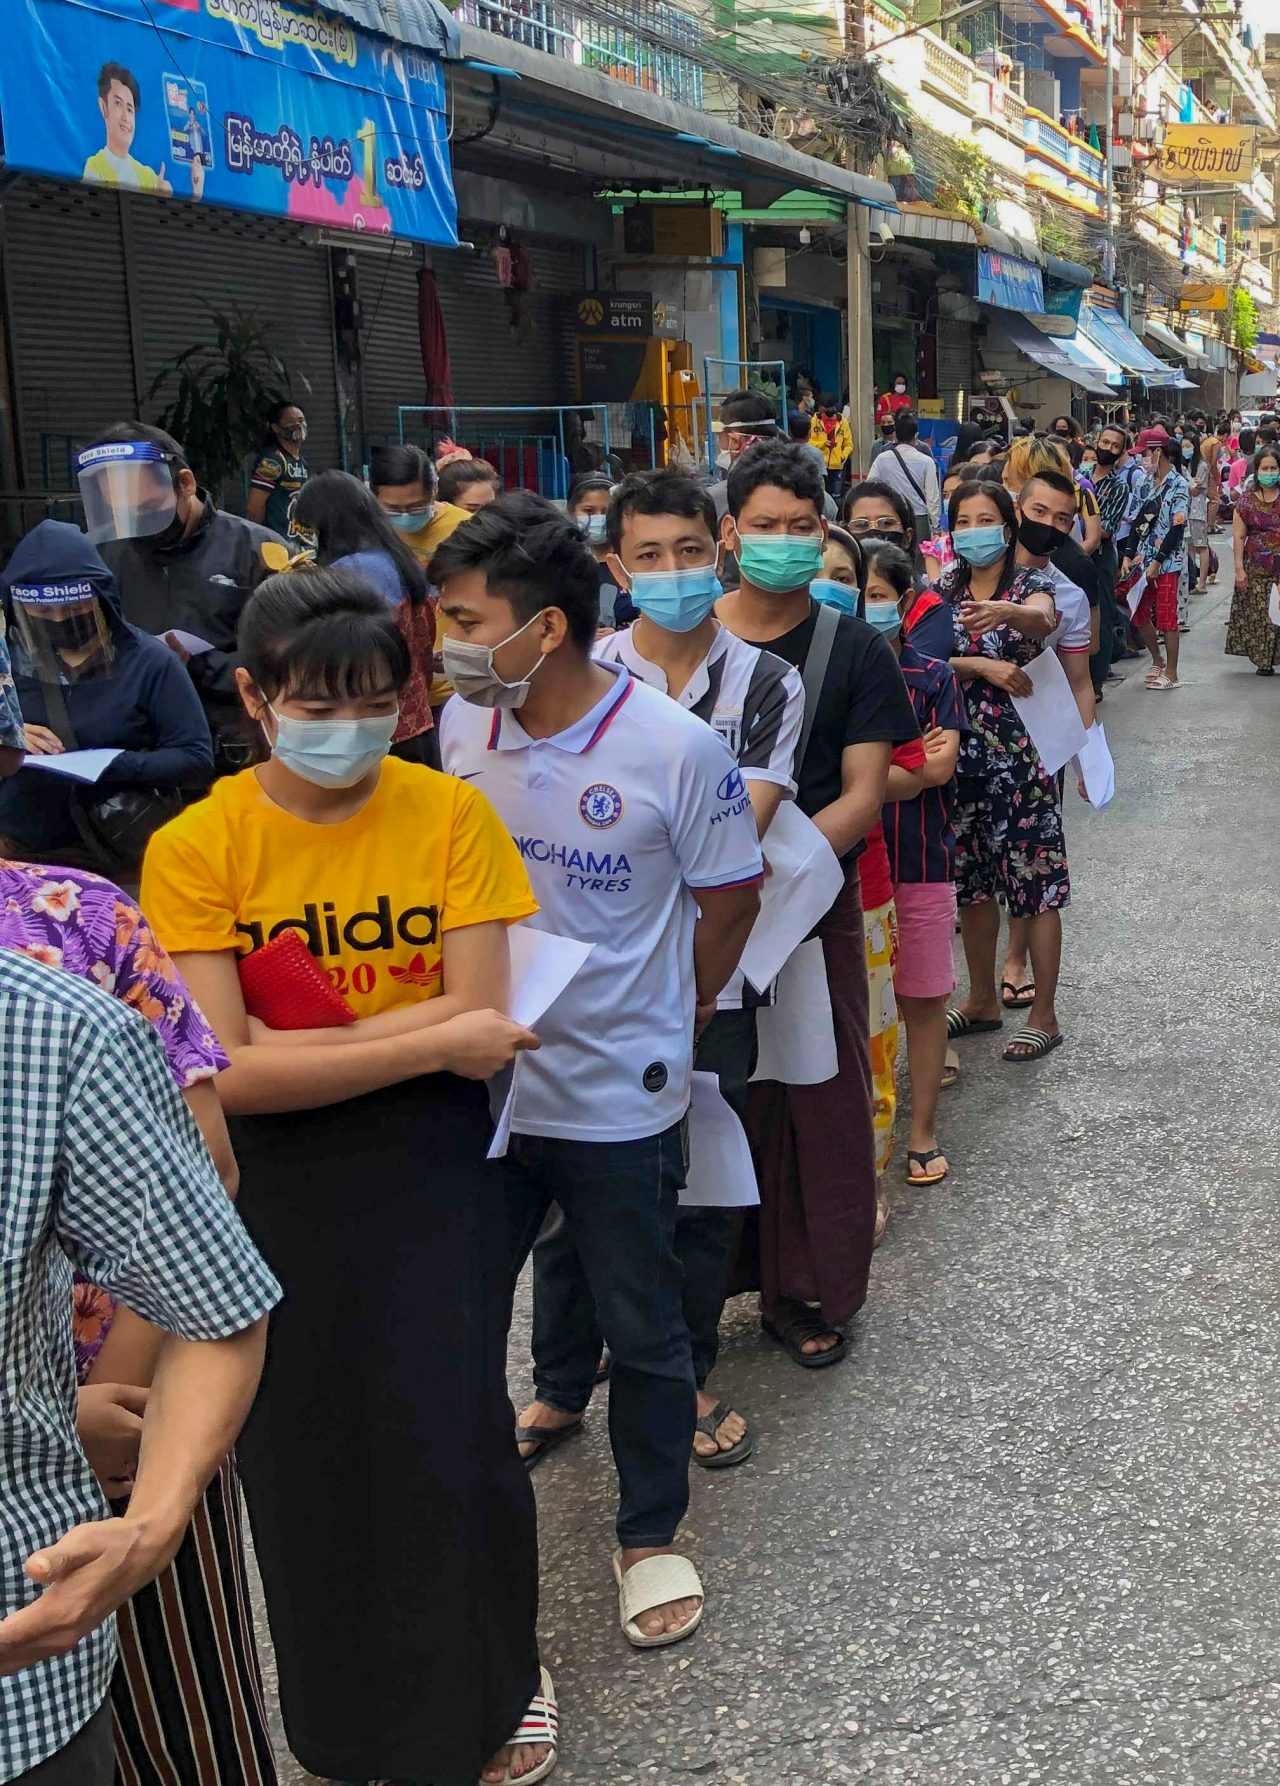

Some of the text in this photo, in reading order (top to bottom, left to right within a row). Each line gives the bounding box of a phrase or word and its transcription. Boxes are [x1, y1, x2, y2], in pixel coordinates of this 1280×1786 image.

[609, 301, 642, 310] krungsri
[610, 313, 642, 327] atm
[10, 582, 91, 597] Face Shield
[566, 873, 632, 892] TYRES
